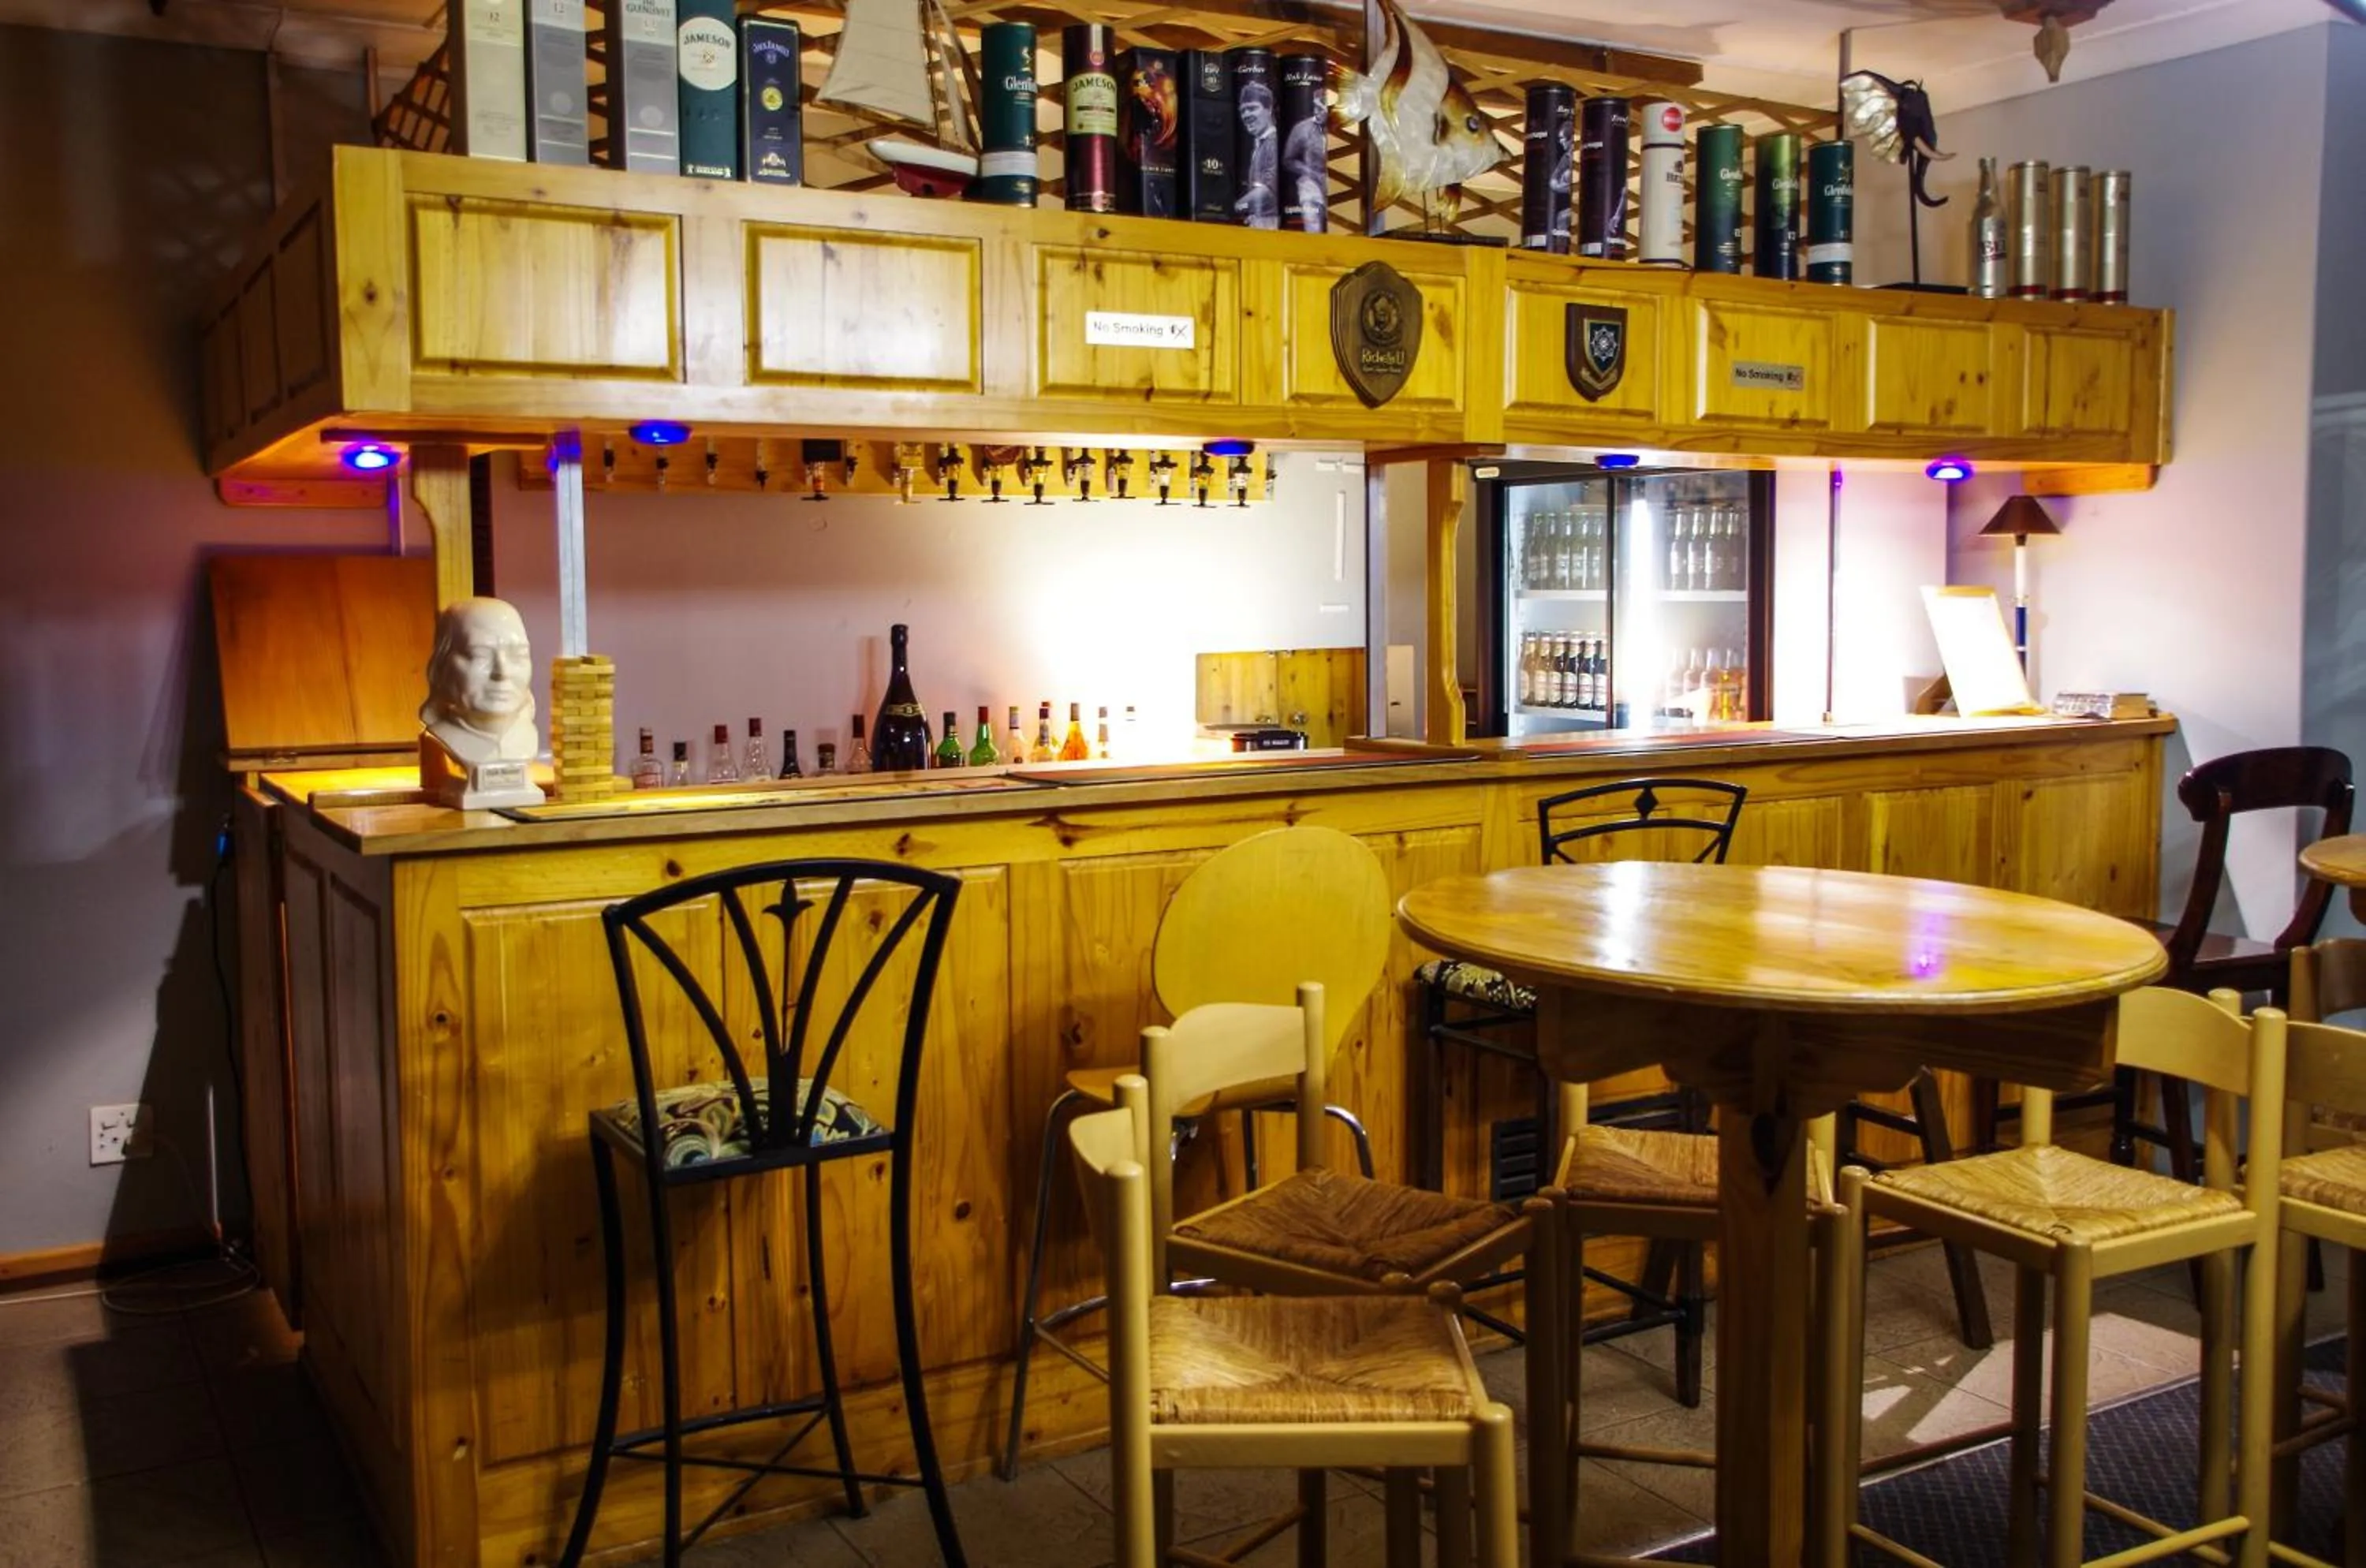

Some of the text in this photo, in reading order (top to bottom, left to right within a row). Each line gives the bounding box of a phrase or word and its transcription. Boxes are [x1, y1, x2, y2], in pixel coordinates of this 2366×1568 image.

[684, 32, 731, 49] JAMESON
[1207, 159, 1219, 170] 10
[1094, 320, 1163, 338] No Smoking
[1736, 368, 1747, 378] No
